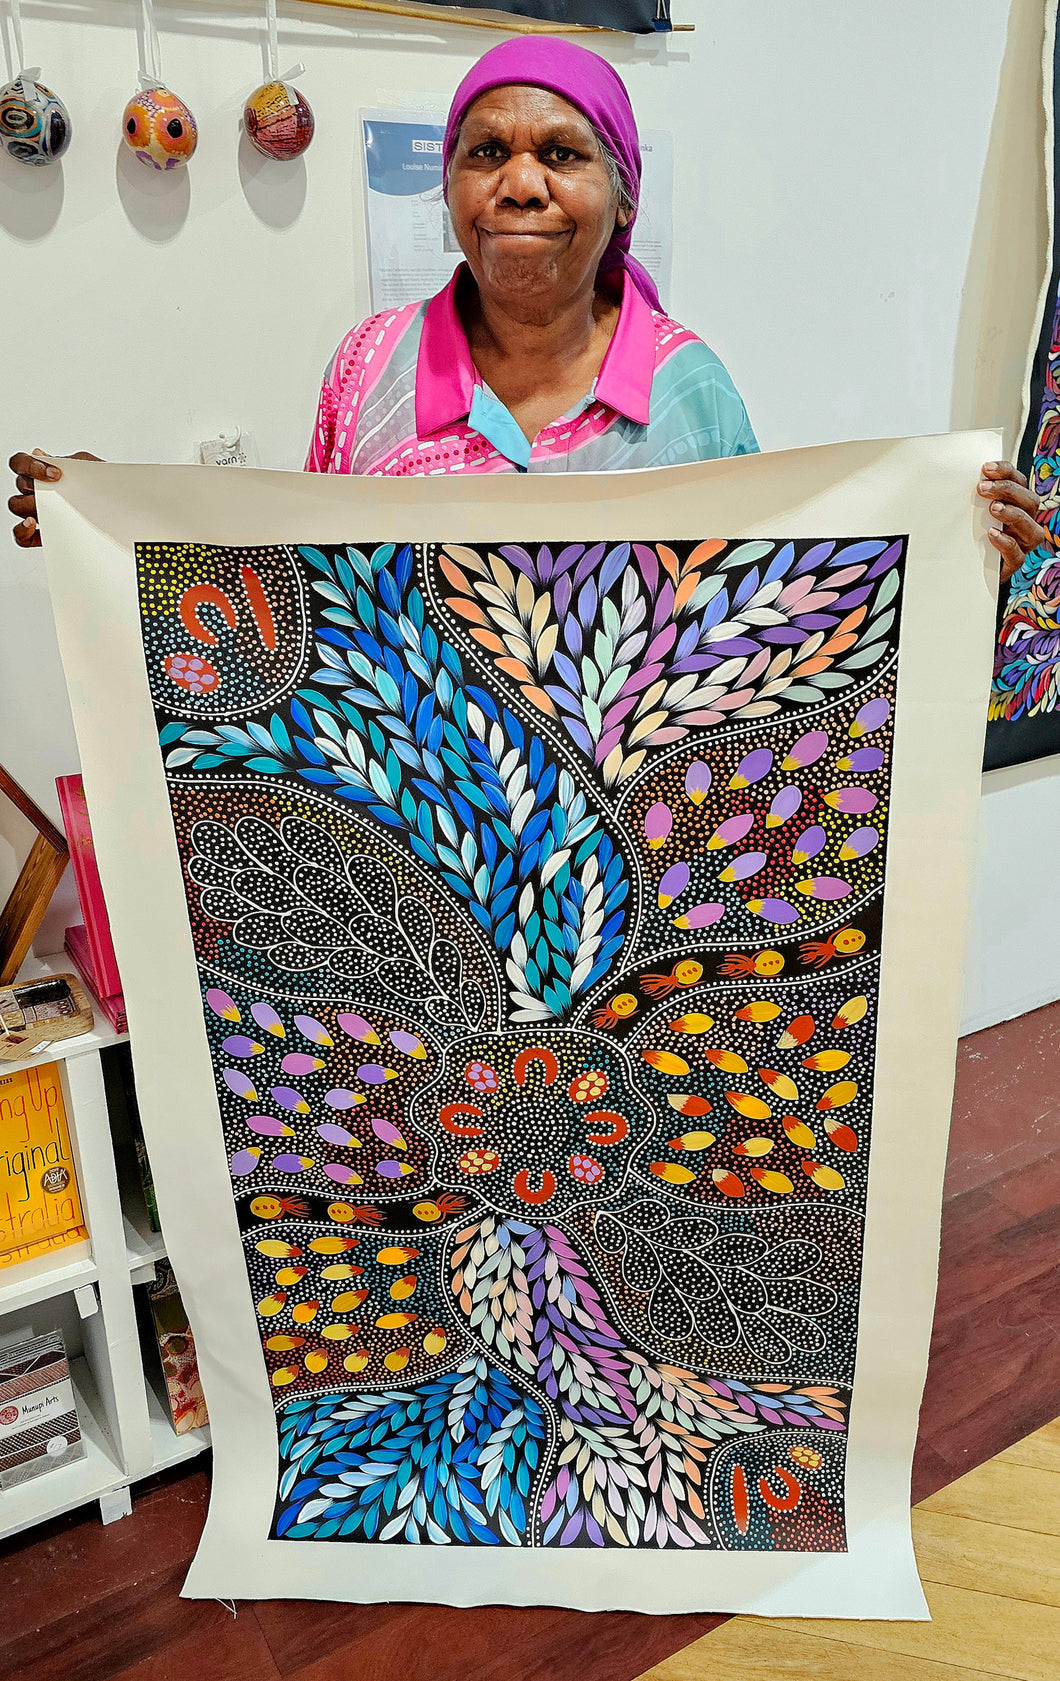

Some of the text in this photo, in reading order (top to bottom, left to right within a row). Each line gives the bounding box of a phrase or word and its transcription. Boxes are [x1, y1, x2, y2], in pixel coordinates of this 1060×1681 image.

[25, 1067, 58, 1134] Up
[21, 1395, 60, 1415] Munupi Arts
